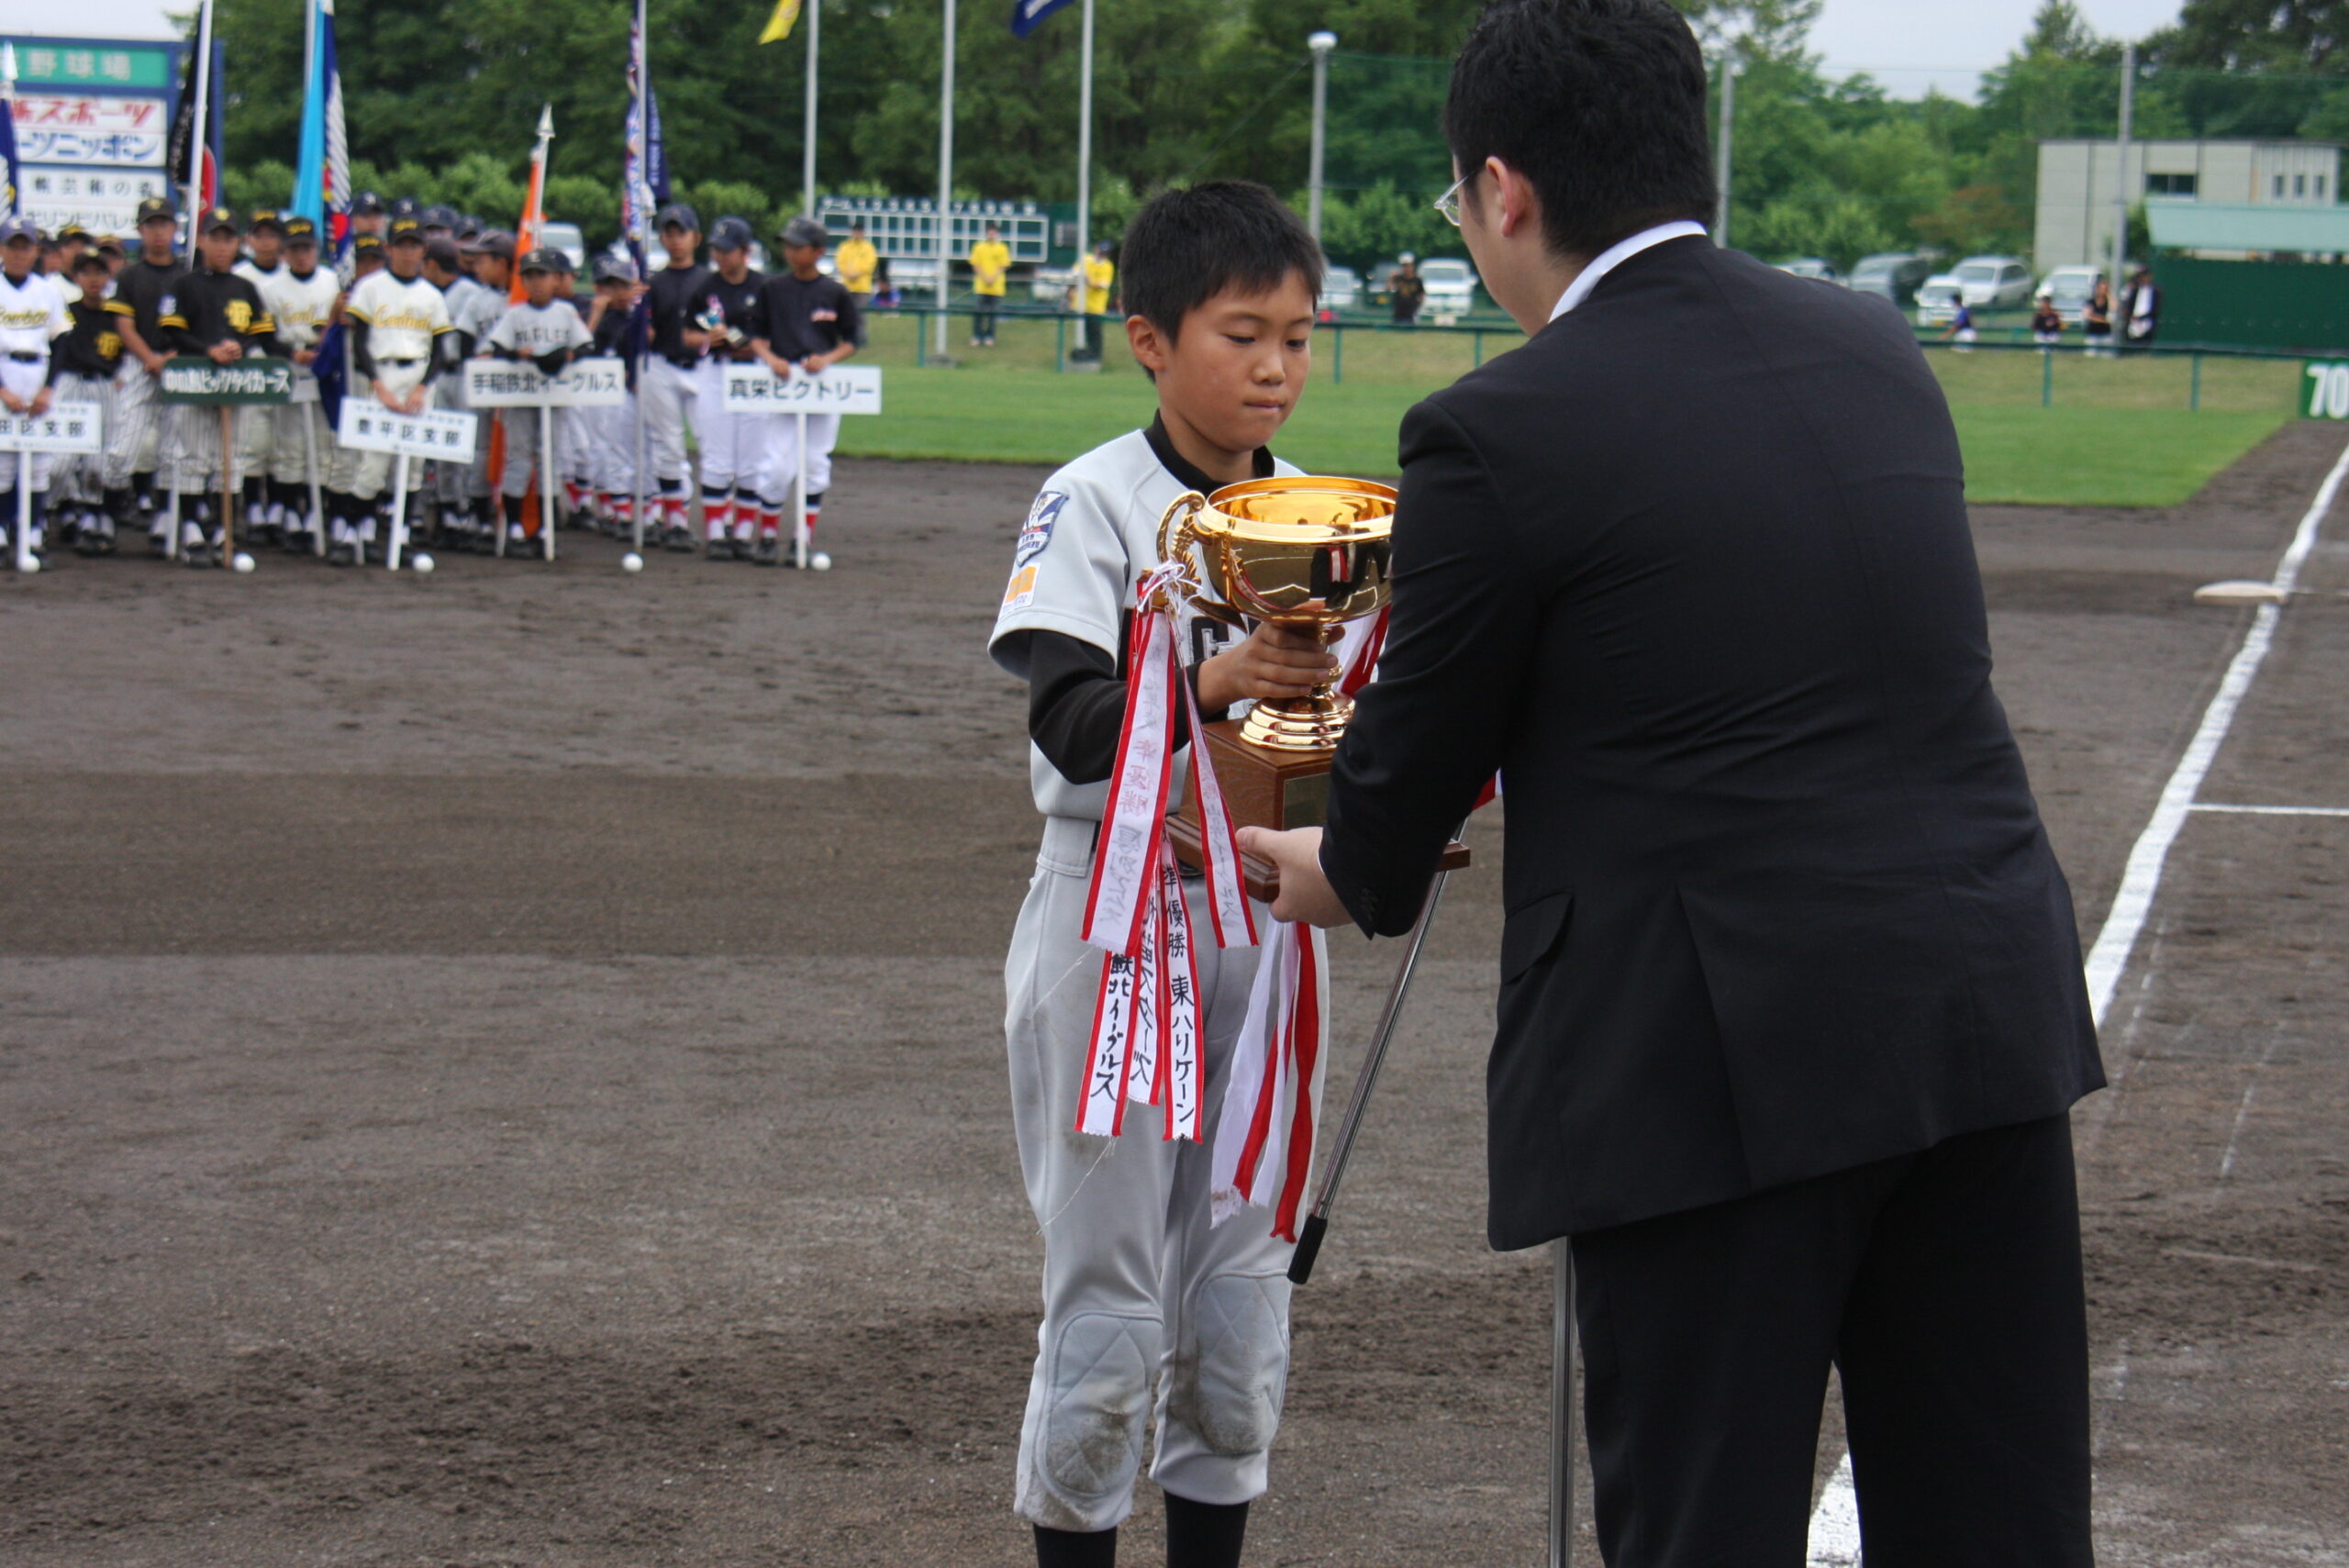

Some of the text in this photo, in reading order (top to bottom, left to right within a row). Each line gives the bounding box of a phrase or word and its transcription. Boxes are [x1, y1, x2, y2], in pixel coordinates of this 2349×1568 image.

[2306, 364, 2349, 418] 70
[1164, 864, 1187, 959] 準優勝
